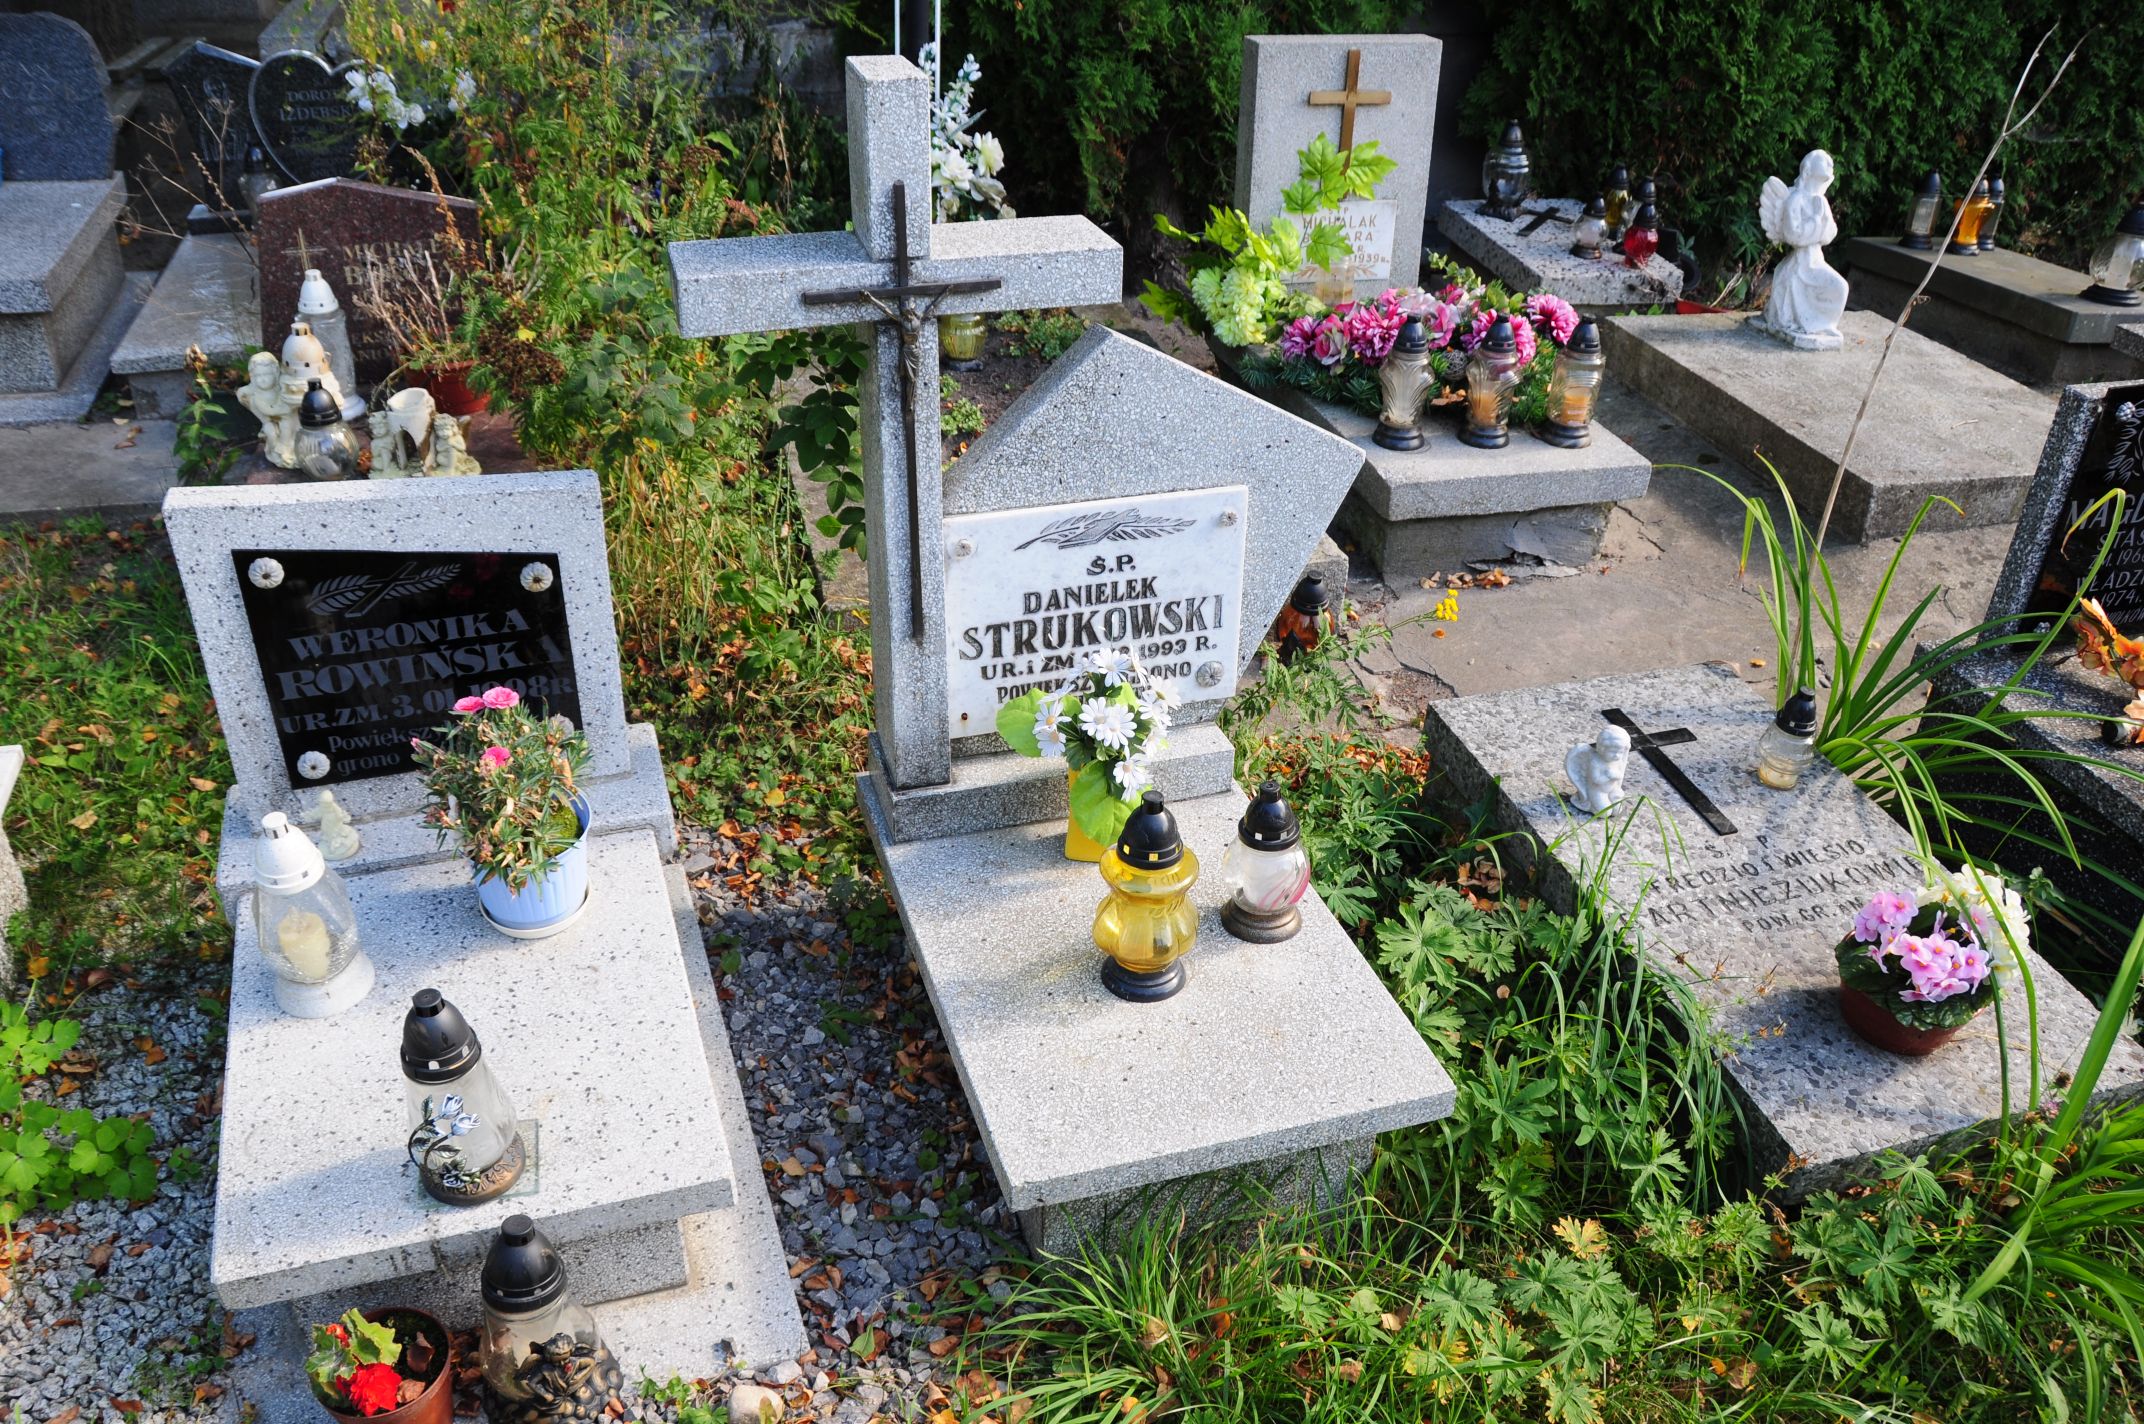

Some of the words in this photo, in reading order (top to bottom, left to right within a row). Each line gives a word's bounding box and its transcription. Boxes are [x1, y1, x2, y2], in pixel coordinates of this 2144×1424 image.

[278, 105, 352, 121] IZDEBSK
[1302, 230, 1374, 243] BARA
[1022, 575, 1158, 615] DANIELEK
[287, 607, 531, 662] WERONIKA
[958, 593, 1225, 661] STRUKOWSKI
[275, 634, 567, 702] ROWIŃSKA
[336, 753, 401, 776] grono
